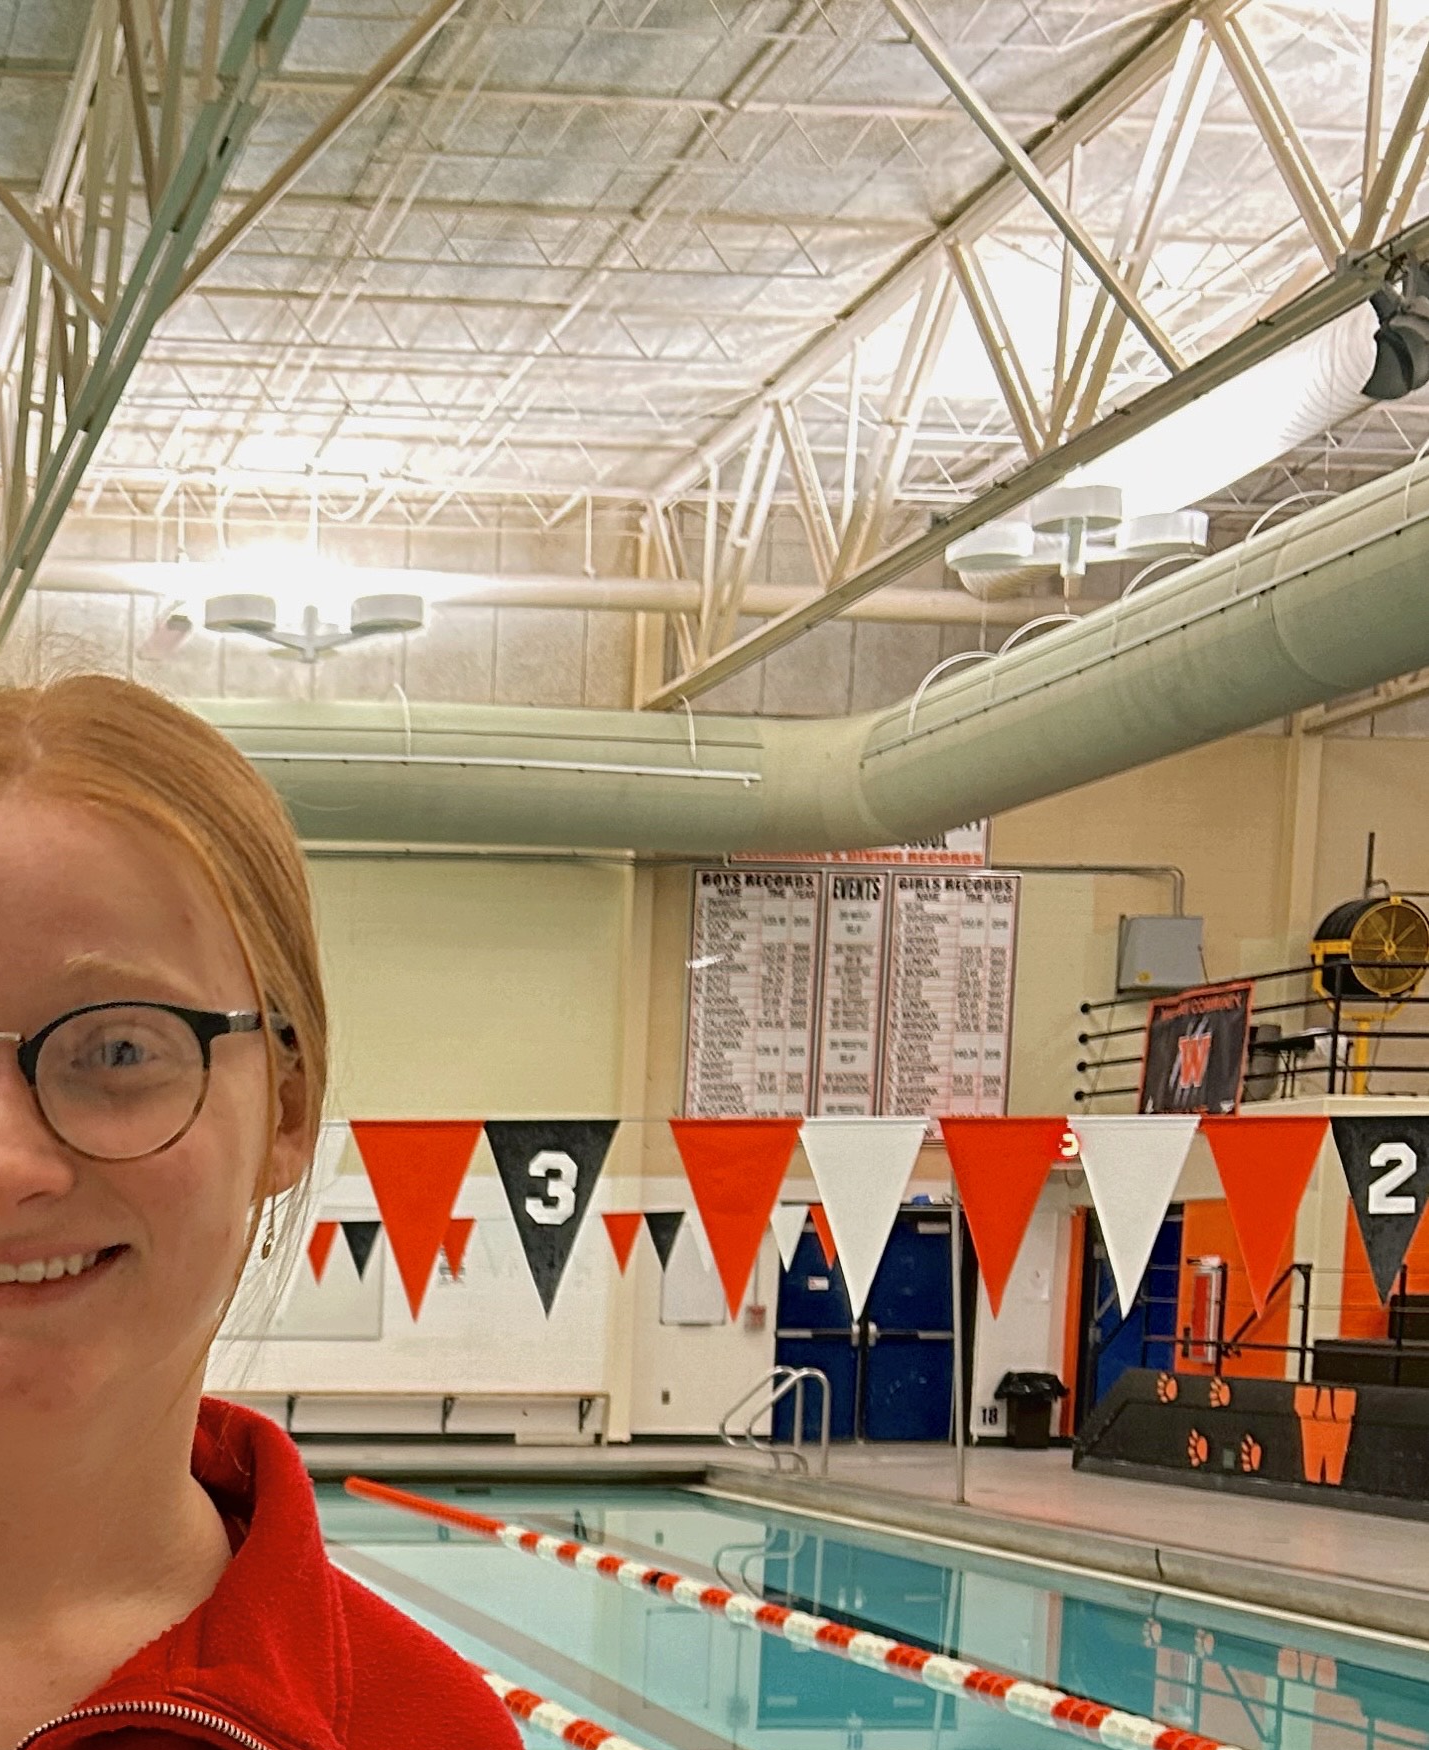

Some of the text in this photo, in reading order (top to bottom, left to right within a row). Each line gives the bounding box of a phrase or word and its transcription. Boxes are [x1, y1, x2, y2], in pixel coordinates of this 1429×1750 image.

[908, 852, 984, 865] RECORDS
[702, 874, 814, 888] BOYS RECORDS
[833, 877, 881, 901] EVENTS
[899, 878, 1013, 892] GIRLS RECORDS
[1179, 1032, 1212, 1089] W
[524, 1151, 579, 1226] 3
[1368, 1142, 1418, 1215] 2
[1294, 1384, 1357, 1486] W
